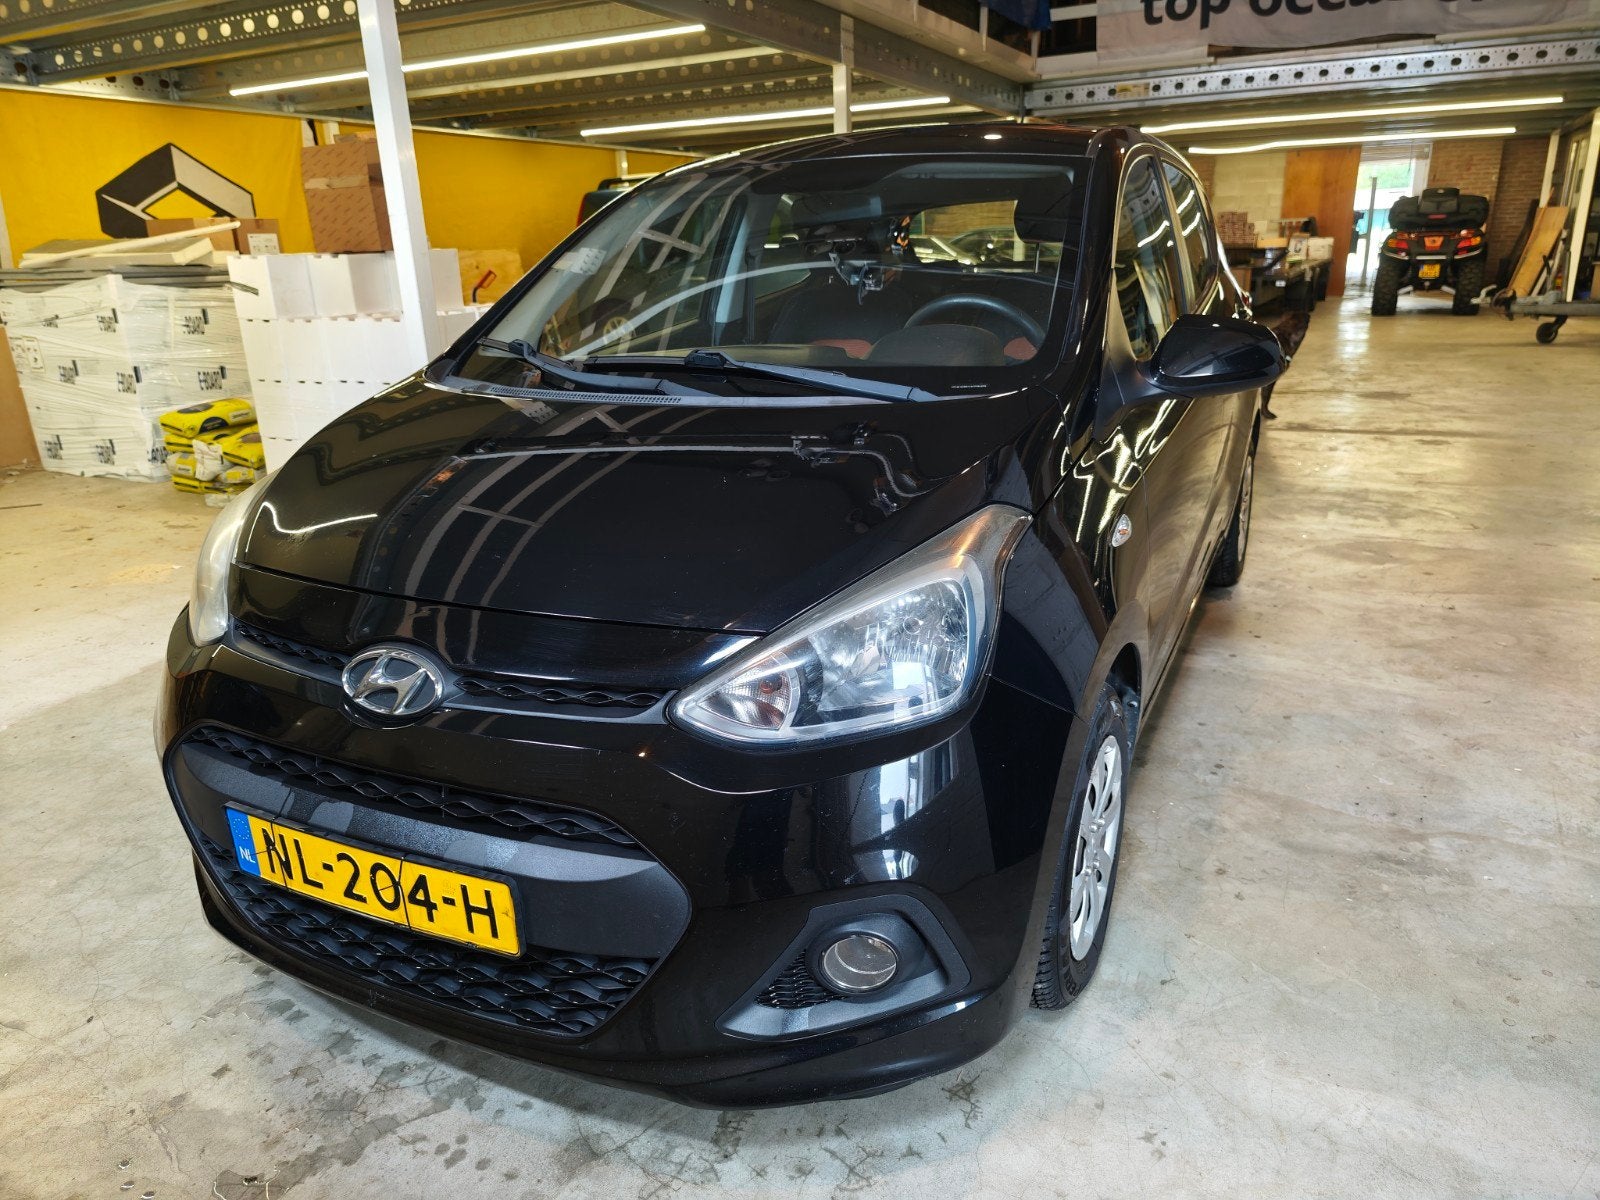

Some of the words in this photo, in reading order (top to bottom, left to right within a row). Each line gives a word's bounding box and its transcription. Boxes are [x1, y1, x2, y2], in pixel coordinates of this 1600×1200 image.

[1140, 0, 1230, 30] top
[239, 845, 256, 863] NL
[261, 827, 499, 940] NL-204-H
